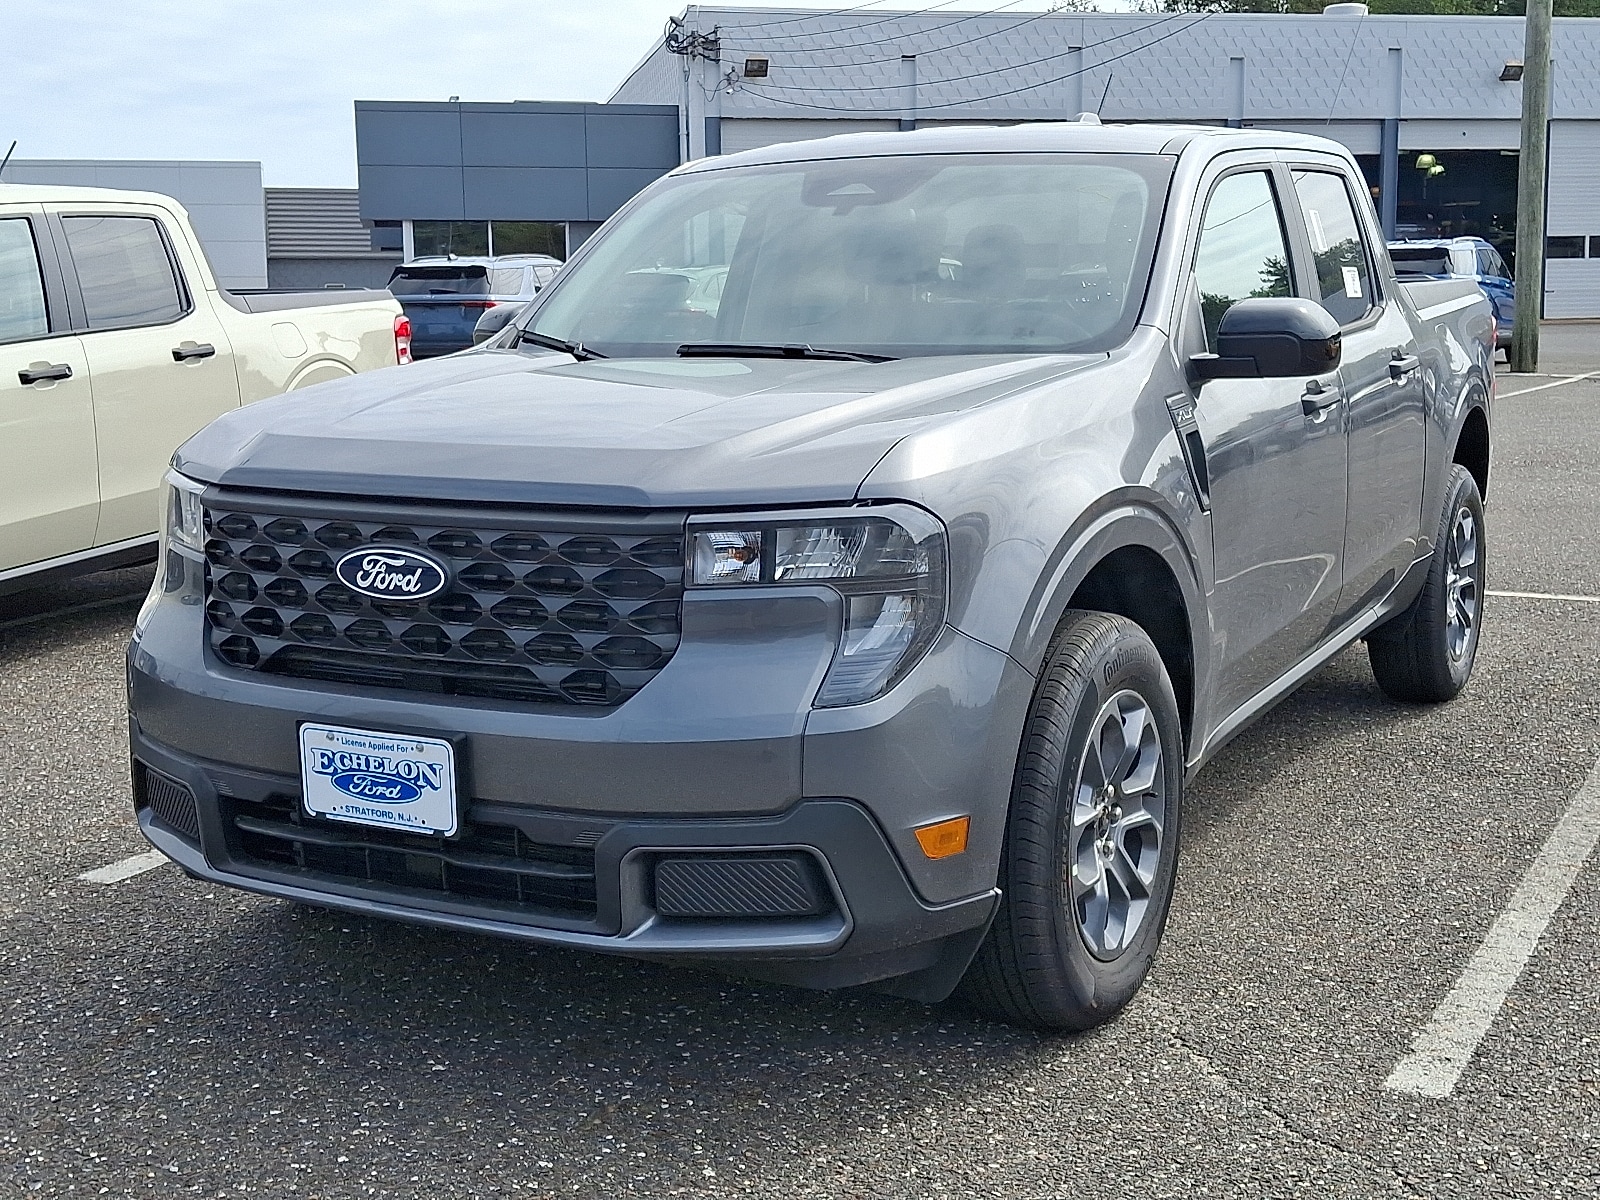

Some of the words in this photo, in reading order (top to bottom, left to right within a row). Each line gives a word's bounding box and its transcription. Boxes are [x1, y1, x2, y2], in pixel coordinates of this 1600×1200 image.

[356, 555, 423, 592] Ford
[341, 737, 366, 748] License
[368, 741, 395, 752] Applied
[396, 744, 409, 753] For
[311, 748, 443, 791] ECHELON
[349, 774, 401, 799] Ford
[345, 805, 396, 821] STRATFORD,
[398, 814, 413, 822] N.J.
